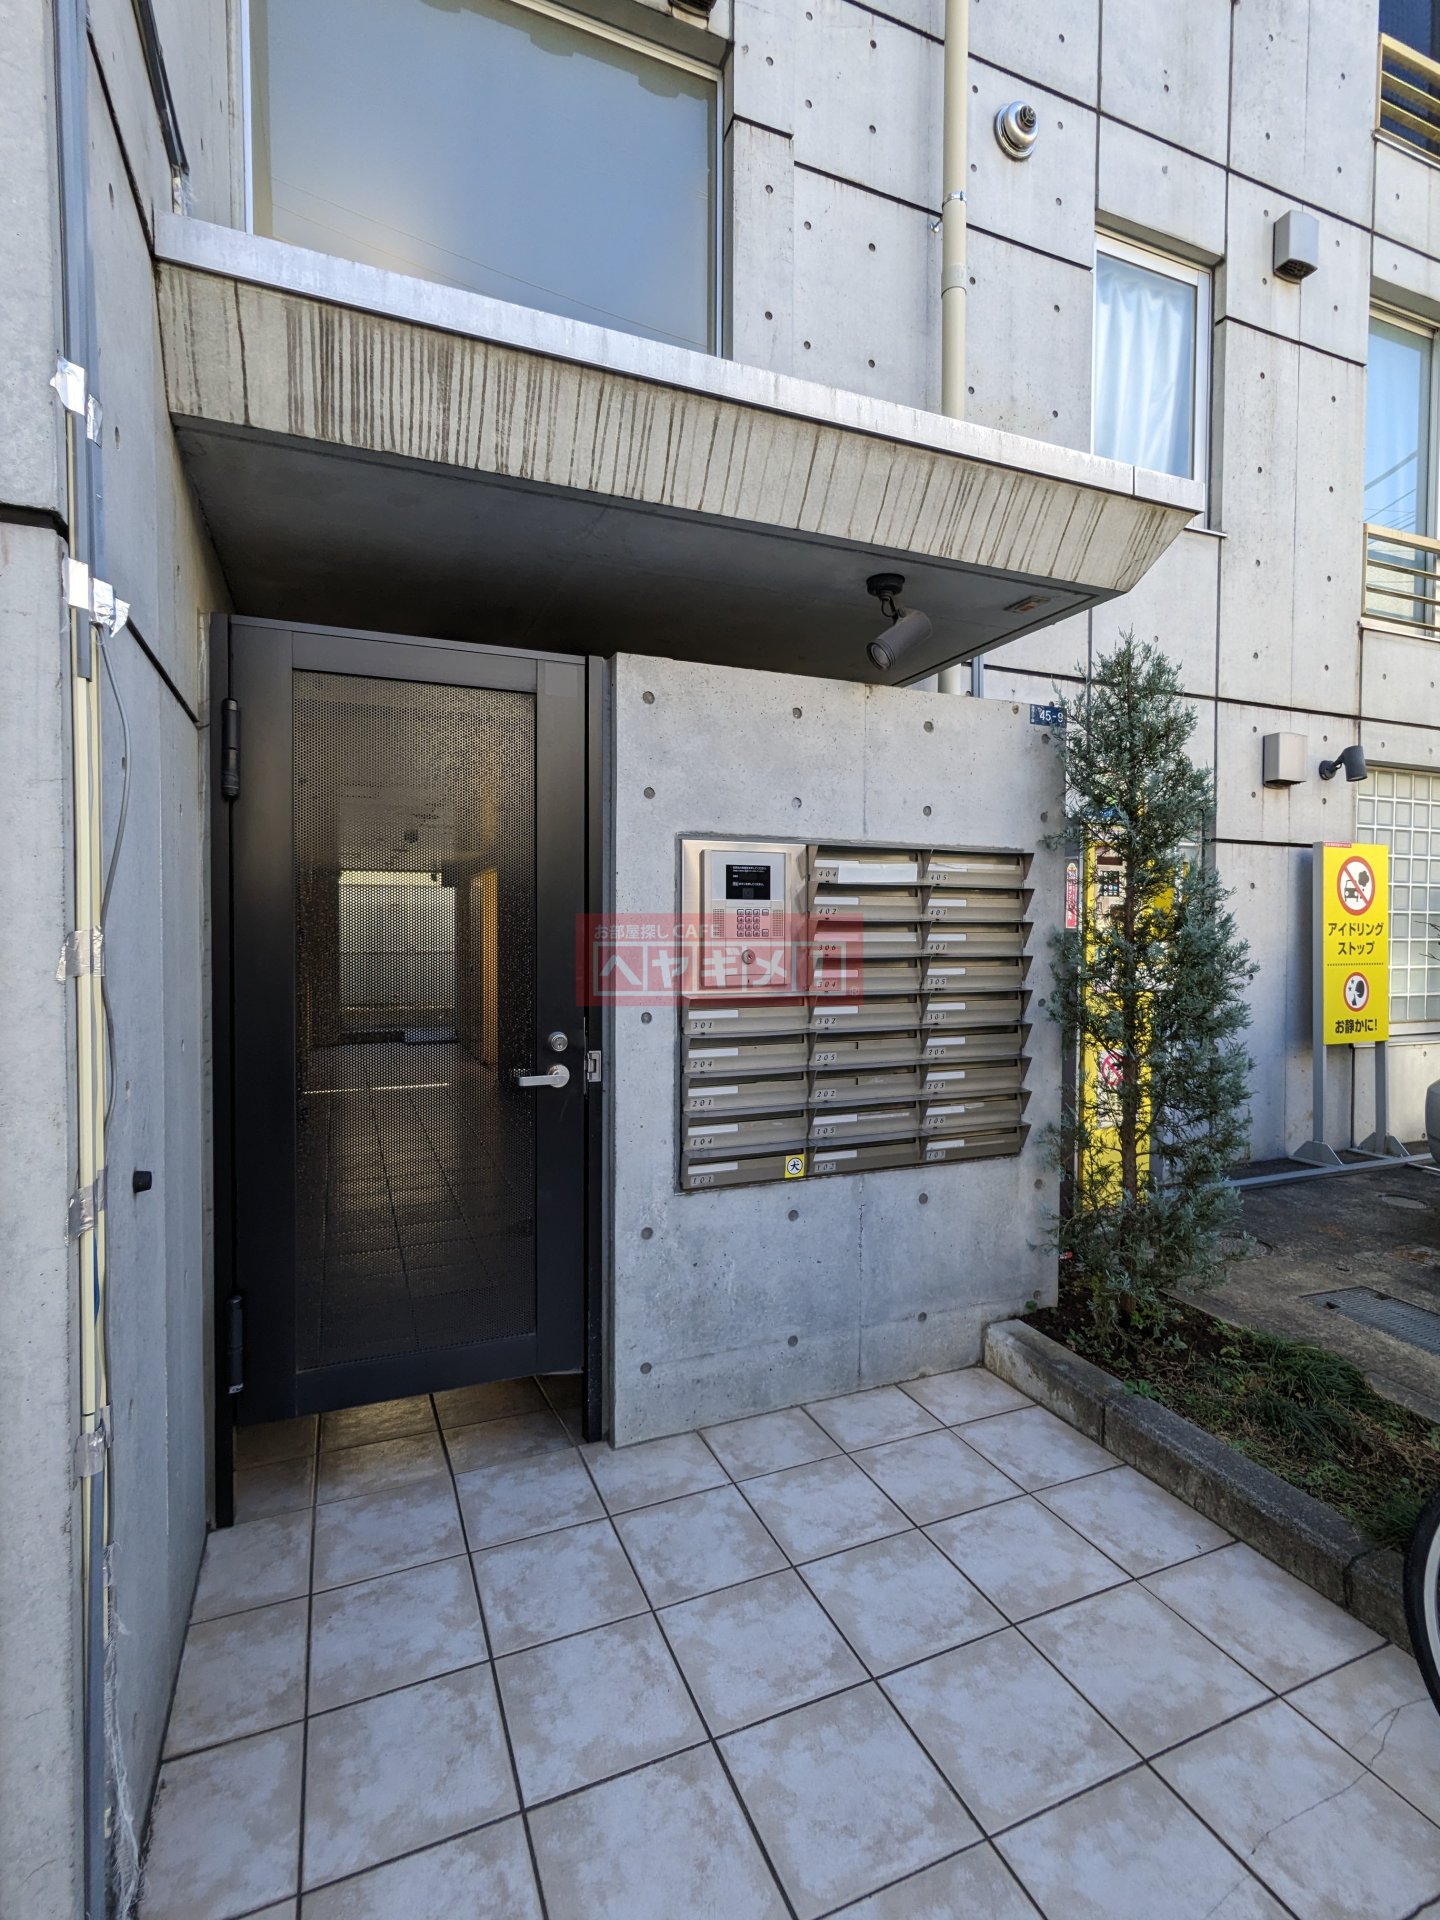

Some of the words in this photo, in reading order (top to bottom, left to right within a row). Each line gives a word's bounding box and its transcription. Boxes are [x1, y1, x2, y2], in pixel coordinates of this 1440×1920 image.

[1040, 709, 1063, 723] 45-9
[818, 870, 836, 878] 404
[1328, 922, 1384, 936] アイドリング
[1338, 941, 1375, 955] ストップ
[693, 1022, 713, 1030] 301
[1335, 1018, 1378, 1034] お静かに!
[816, 1090, 835, 1098] 202
[692, 1099, 712, 1107] 201
[816, 1127, 835, 1135] 105
[692, 1138, 713, 1146] 104
[789, 1159, 801, 1172] 犬
[692, 1176, 712, 1185] 101
